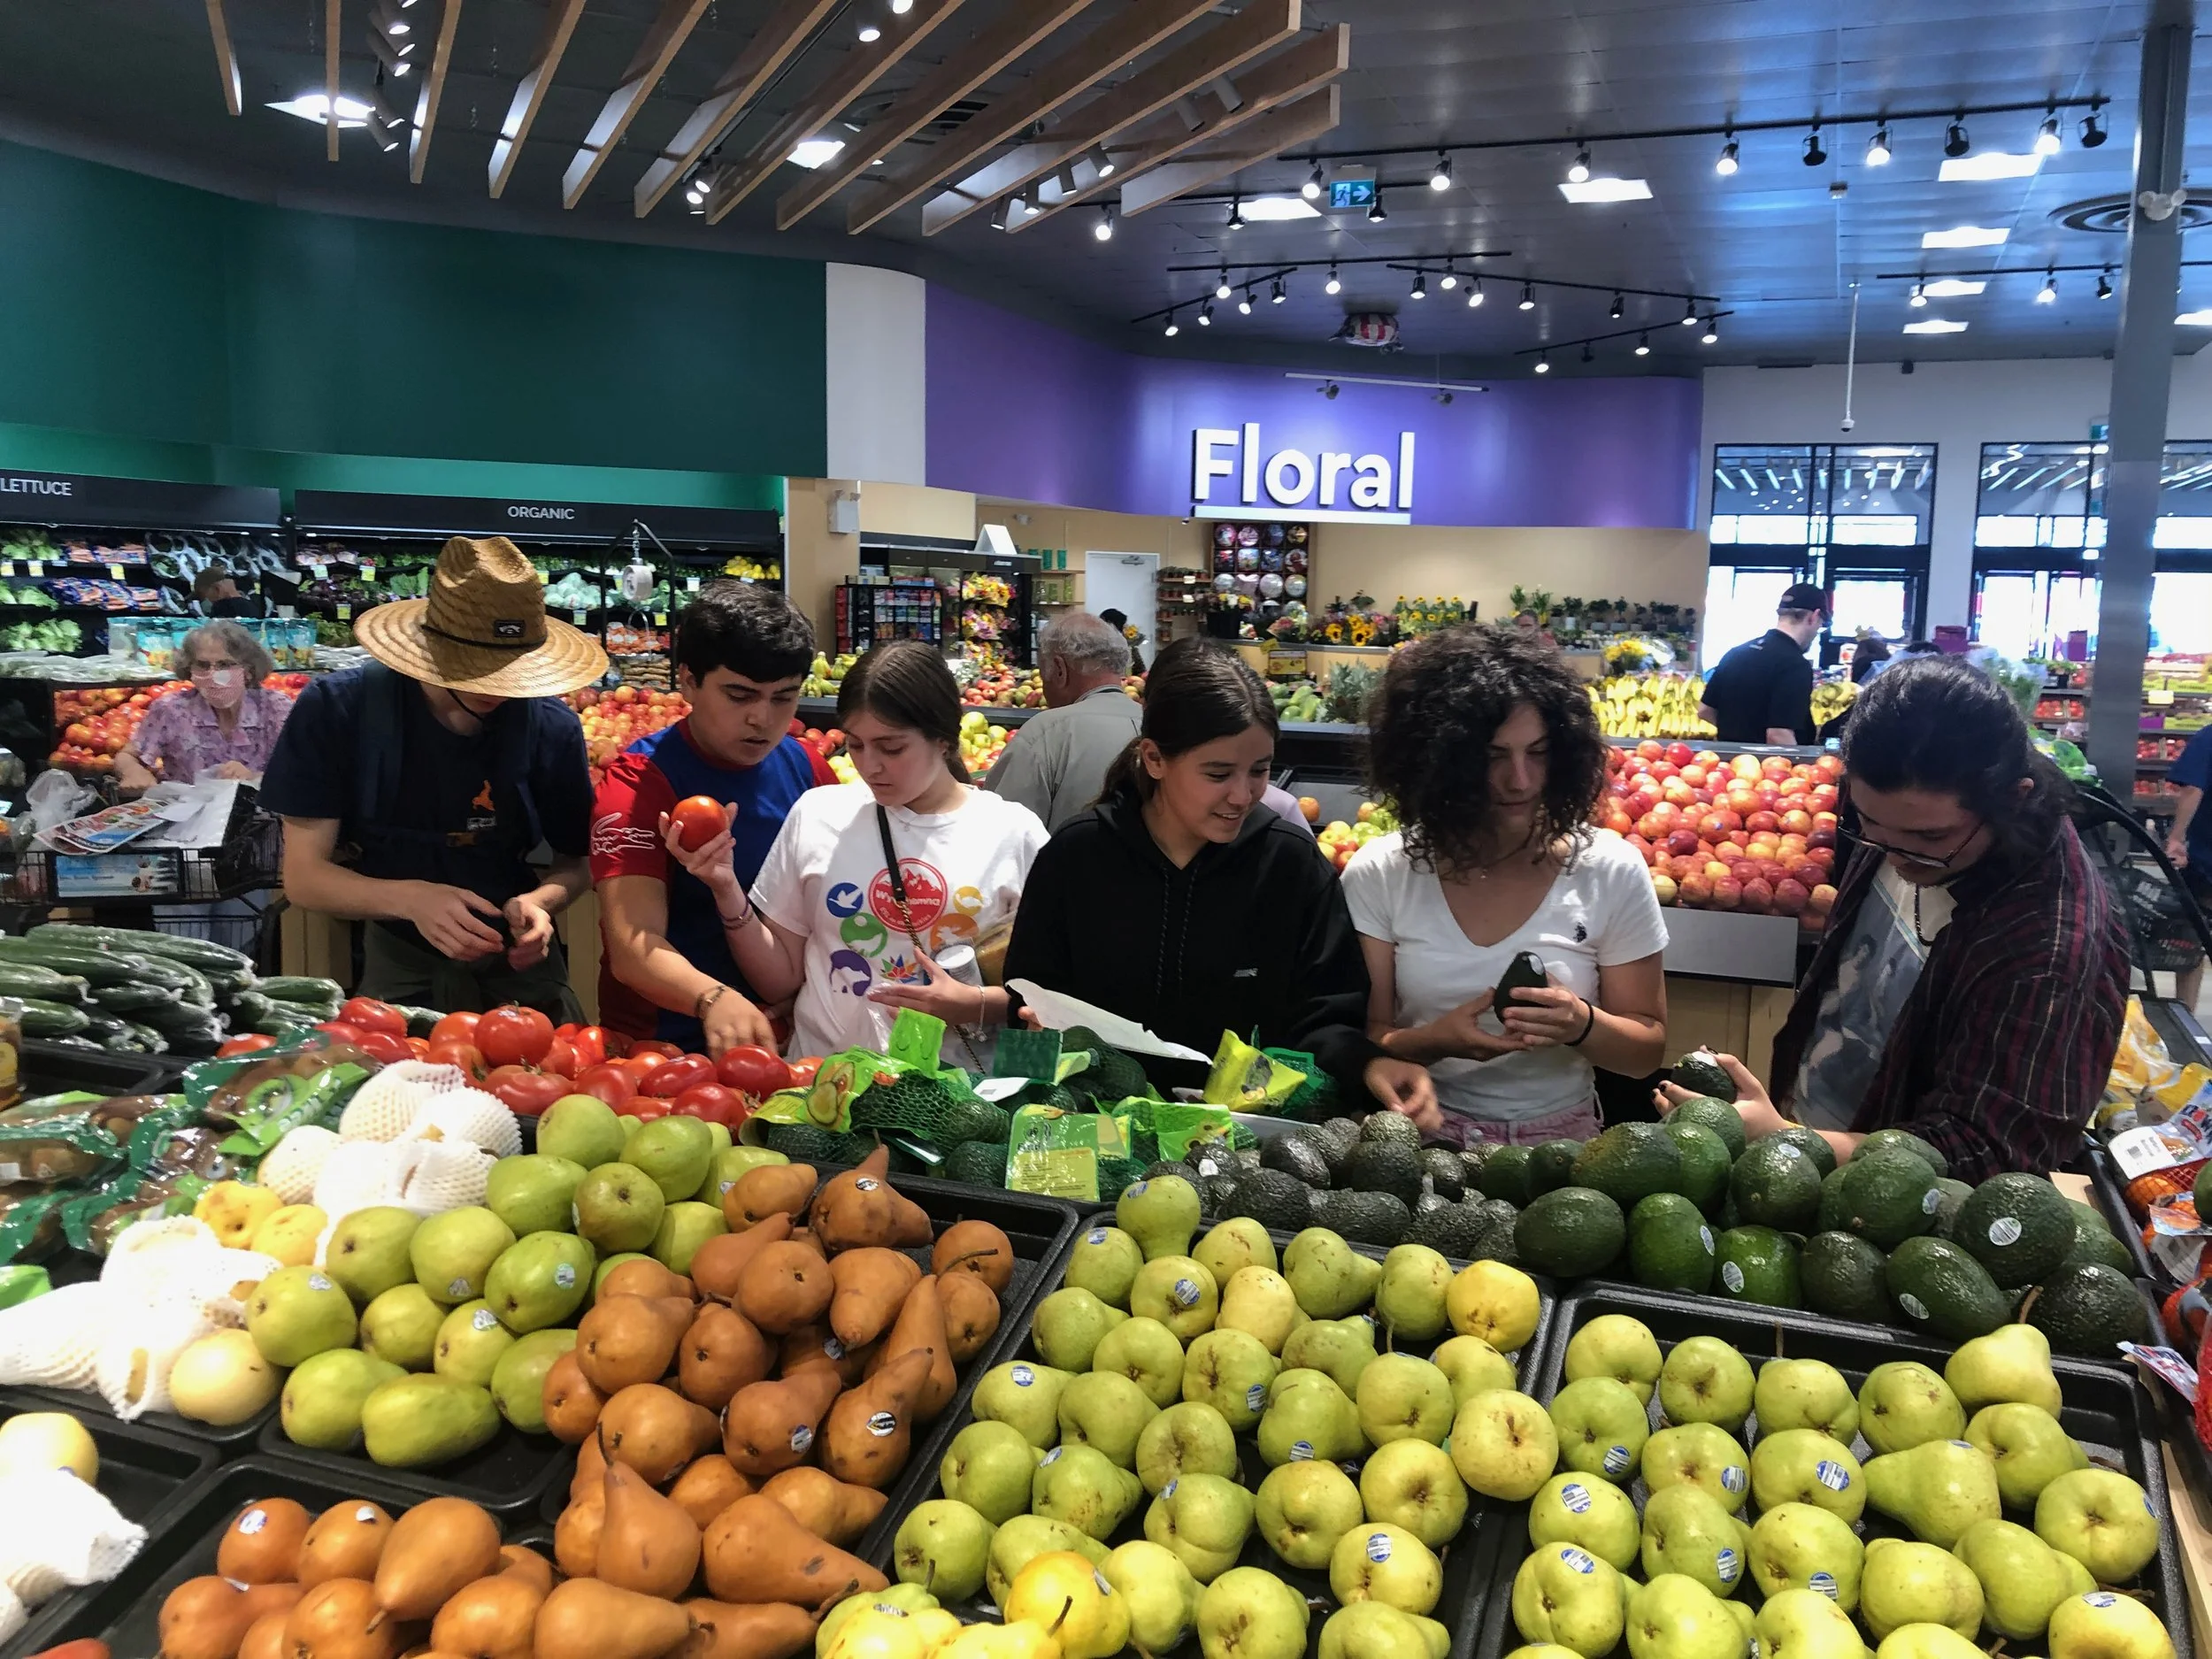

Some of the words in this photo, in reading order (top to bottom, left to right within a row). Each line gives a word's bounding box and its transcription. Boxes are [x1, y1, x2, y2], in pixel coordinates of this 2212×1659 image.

[1194, 423, 1415, 508] Floral
[0, 478, 73, 495] LETTUCE
[507, 506, 575, 519] ORGANIC
